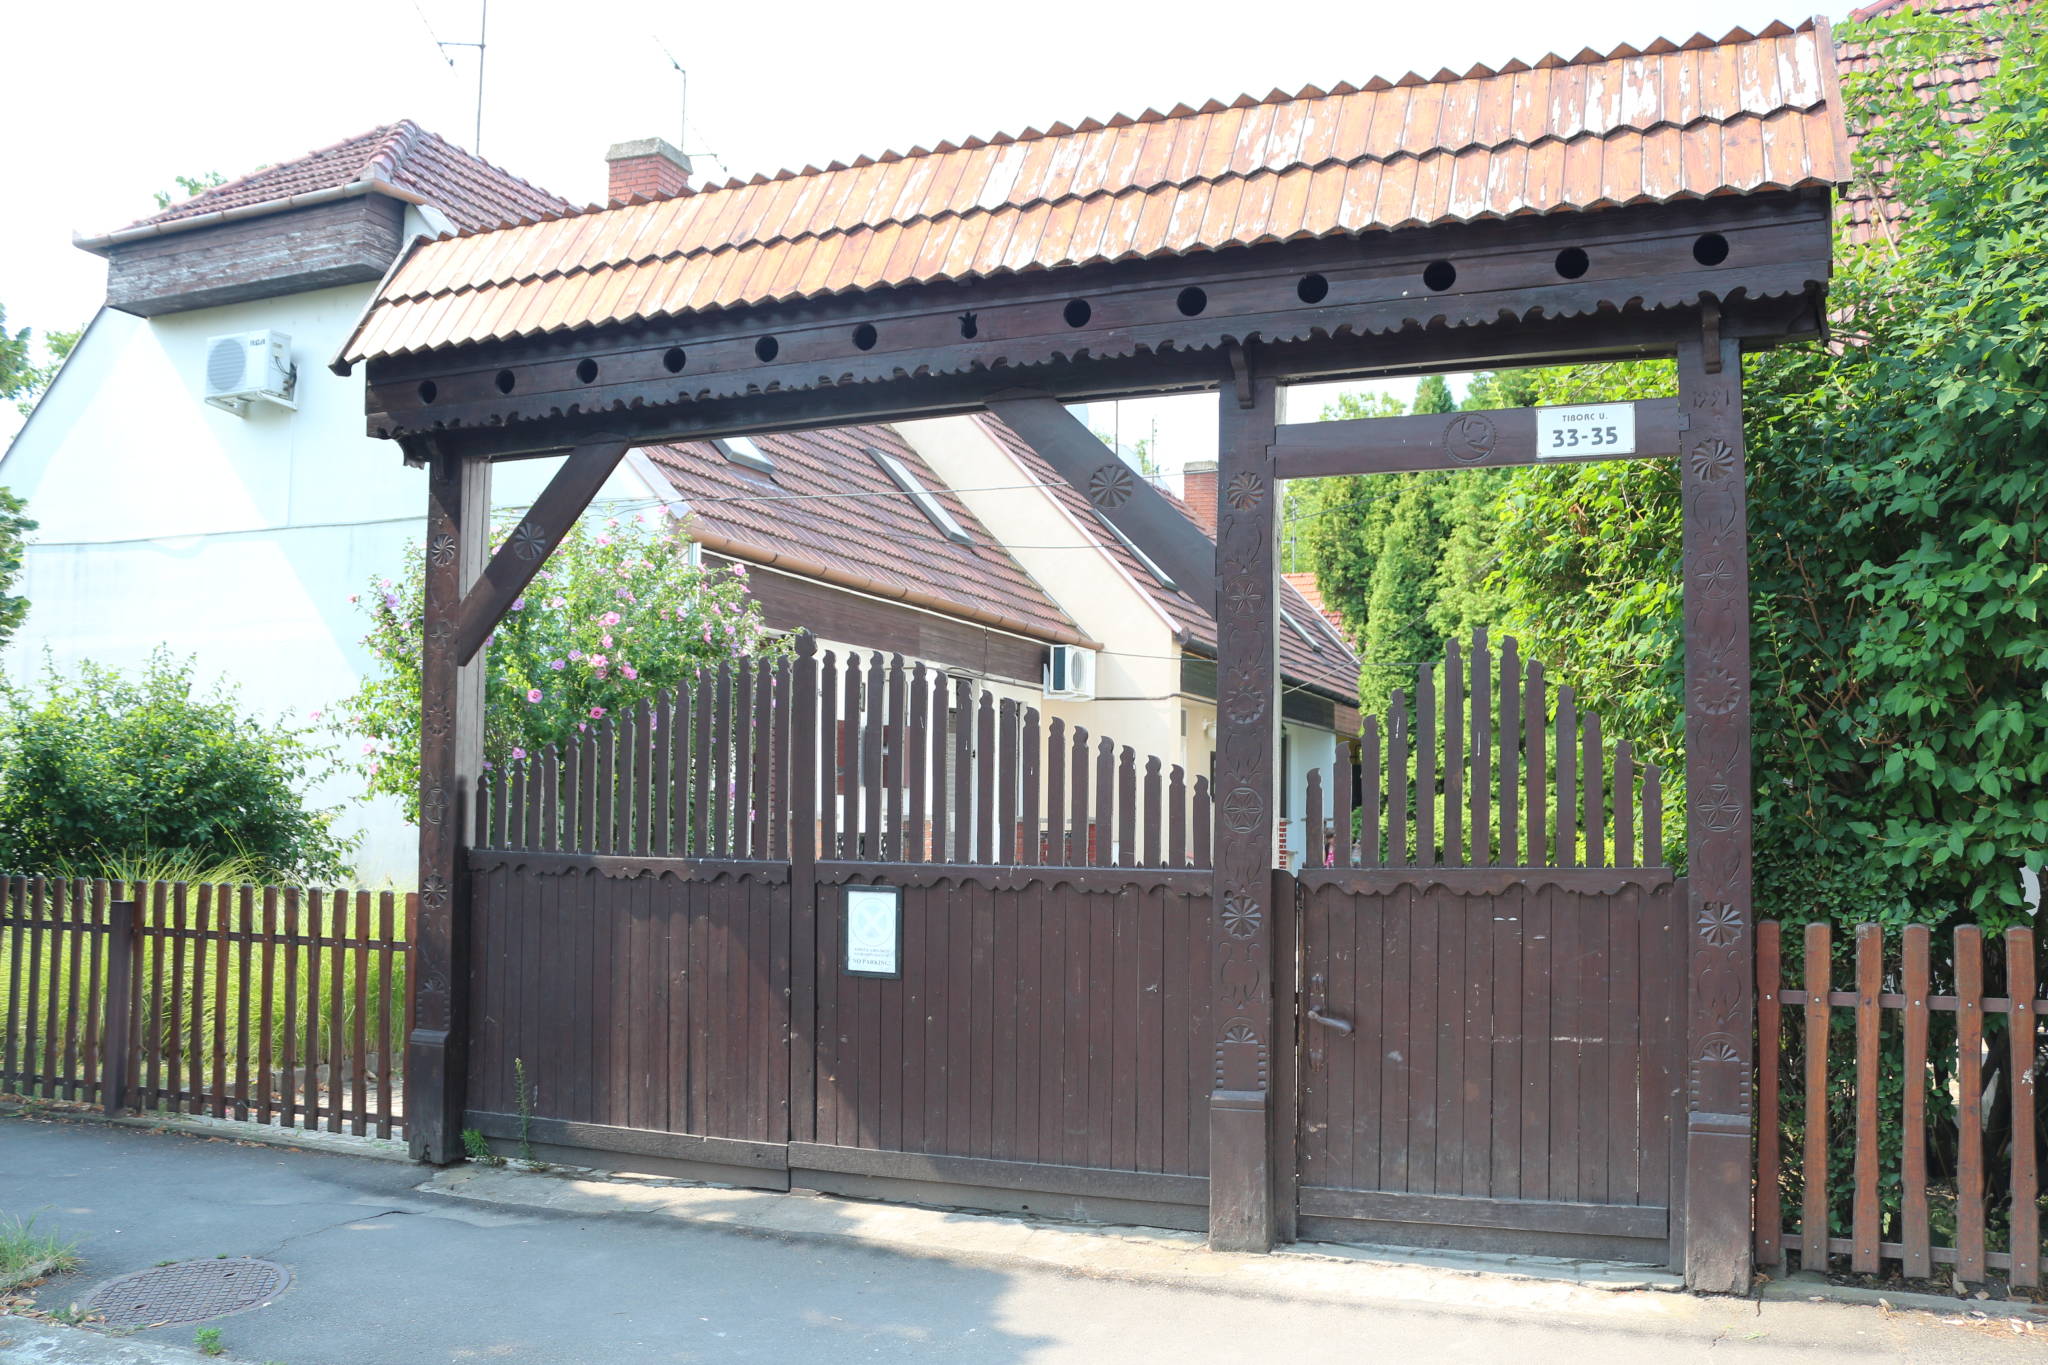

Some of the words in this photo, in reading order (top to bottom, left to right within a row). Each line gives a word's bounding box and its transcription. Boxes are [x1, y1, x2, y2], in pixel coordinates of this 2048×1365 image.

[1692, 386, 1730, 408] 1991
[1562, 413, 1595, 422] TIBORC
[1599, 412, 1608, 420] U.
[1552, 426, 1618, 448] 33-35
